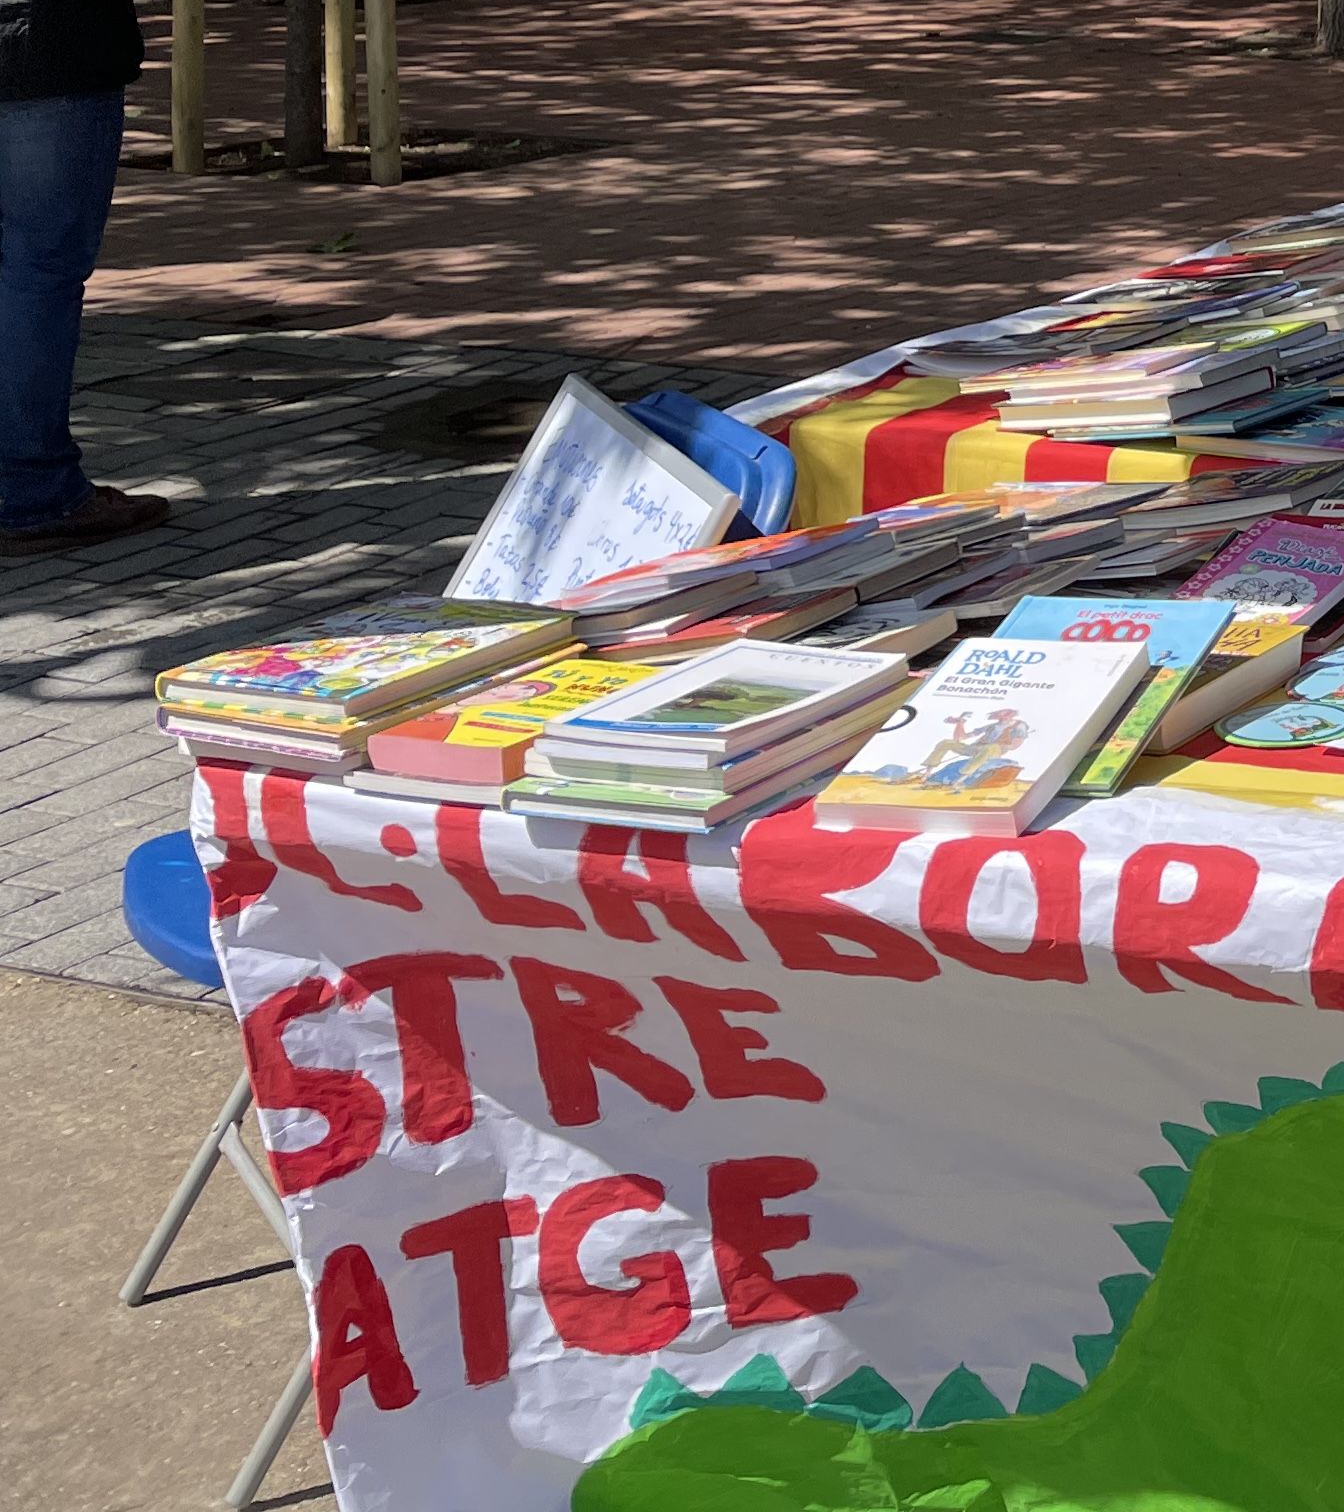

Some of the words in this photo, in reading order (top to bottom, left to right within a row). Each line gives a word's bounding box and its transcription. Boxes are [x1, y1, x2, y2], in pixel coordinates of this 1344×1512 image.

[1247, 548, 1344, 576] PENJADA
[1092, 609, 1129, 620] petit
[1130, 610, 1164, 620] drac
[1060, 619, 1151, 642] COCO
[964, 649, 1047, 665] ROALD
[956, 662, 1024, 679] DAHL
[936, 684, 1009, 696] Bonachón
[944, 676, 959, 684] El
[961, 677, 997, 686] Gran
[999, 679, 1056, 690] Gigante
[243, 951, 827, 1198] STRE
[313, 1155, 861, 1439] ATGE
